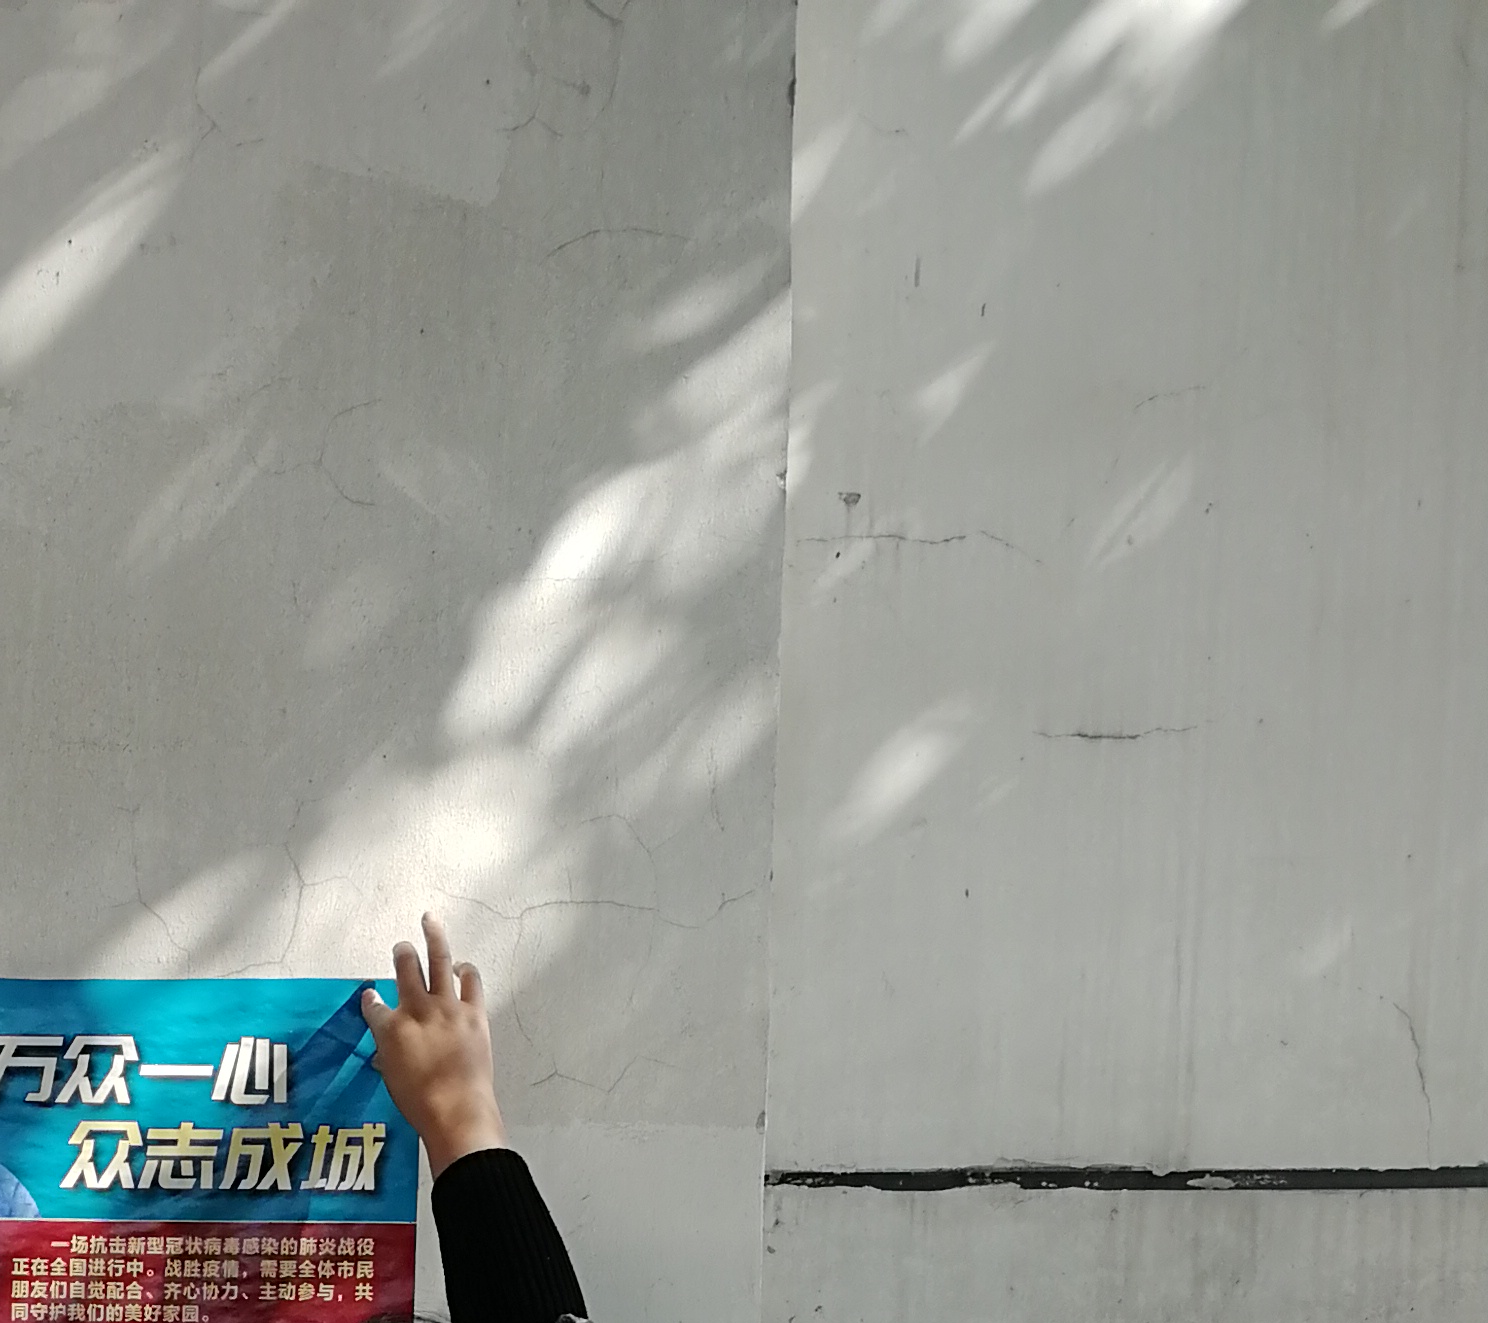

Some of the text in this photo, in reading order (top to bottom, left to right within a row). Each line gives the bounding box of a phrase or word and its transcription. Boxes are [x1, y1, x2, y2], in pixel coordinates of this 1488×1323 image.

[60, 1121, 386, 1191] 众志成城
[51, 1236, 375, 1256] 一场抗击新型冠状病毒感染的肺炎战役
[11, 1257, 375, 1278] 正在全国进行中。战胜疫情，需要全体市民
[11, 1280, 375, 1302] 朋友们自觉配合、齐心协力、主动参与，共
[11, 1303, 211, 1323] 同守护我们的美好家园。
